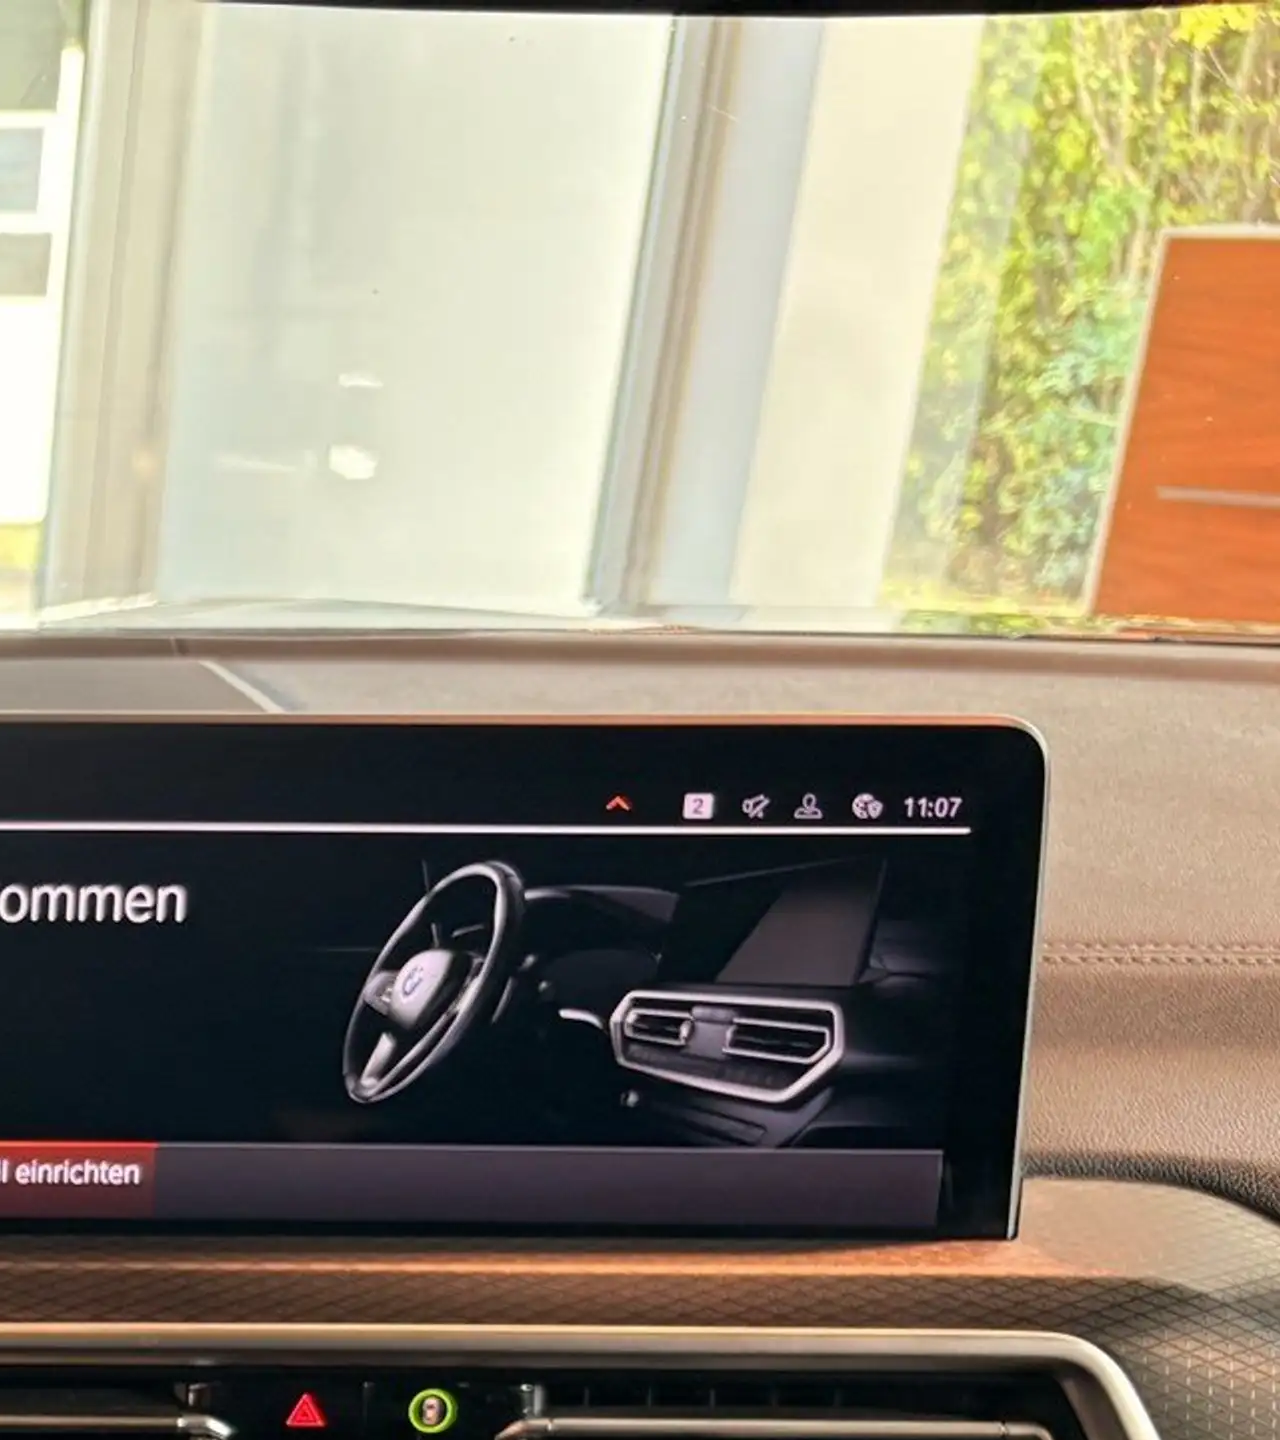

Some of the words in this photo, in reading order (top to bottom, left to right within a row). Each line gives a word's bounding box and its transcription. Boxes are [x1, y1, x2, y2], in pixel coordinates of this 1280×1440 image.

[692, 798, 705, 815] 2
[904, 796, 963, 819] 11:07
[14, 1159, 141, 1186] einrichten
